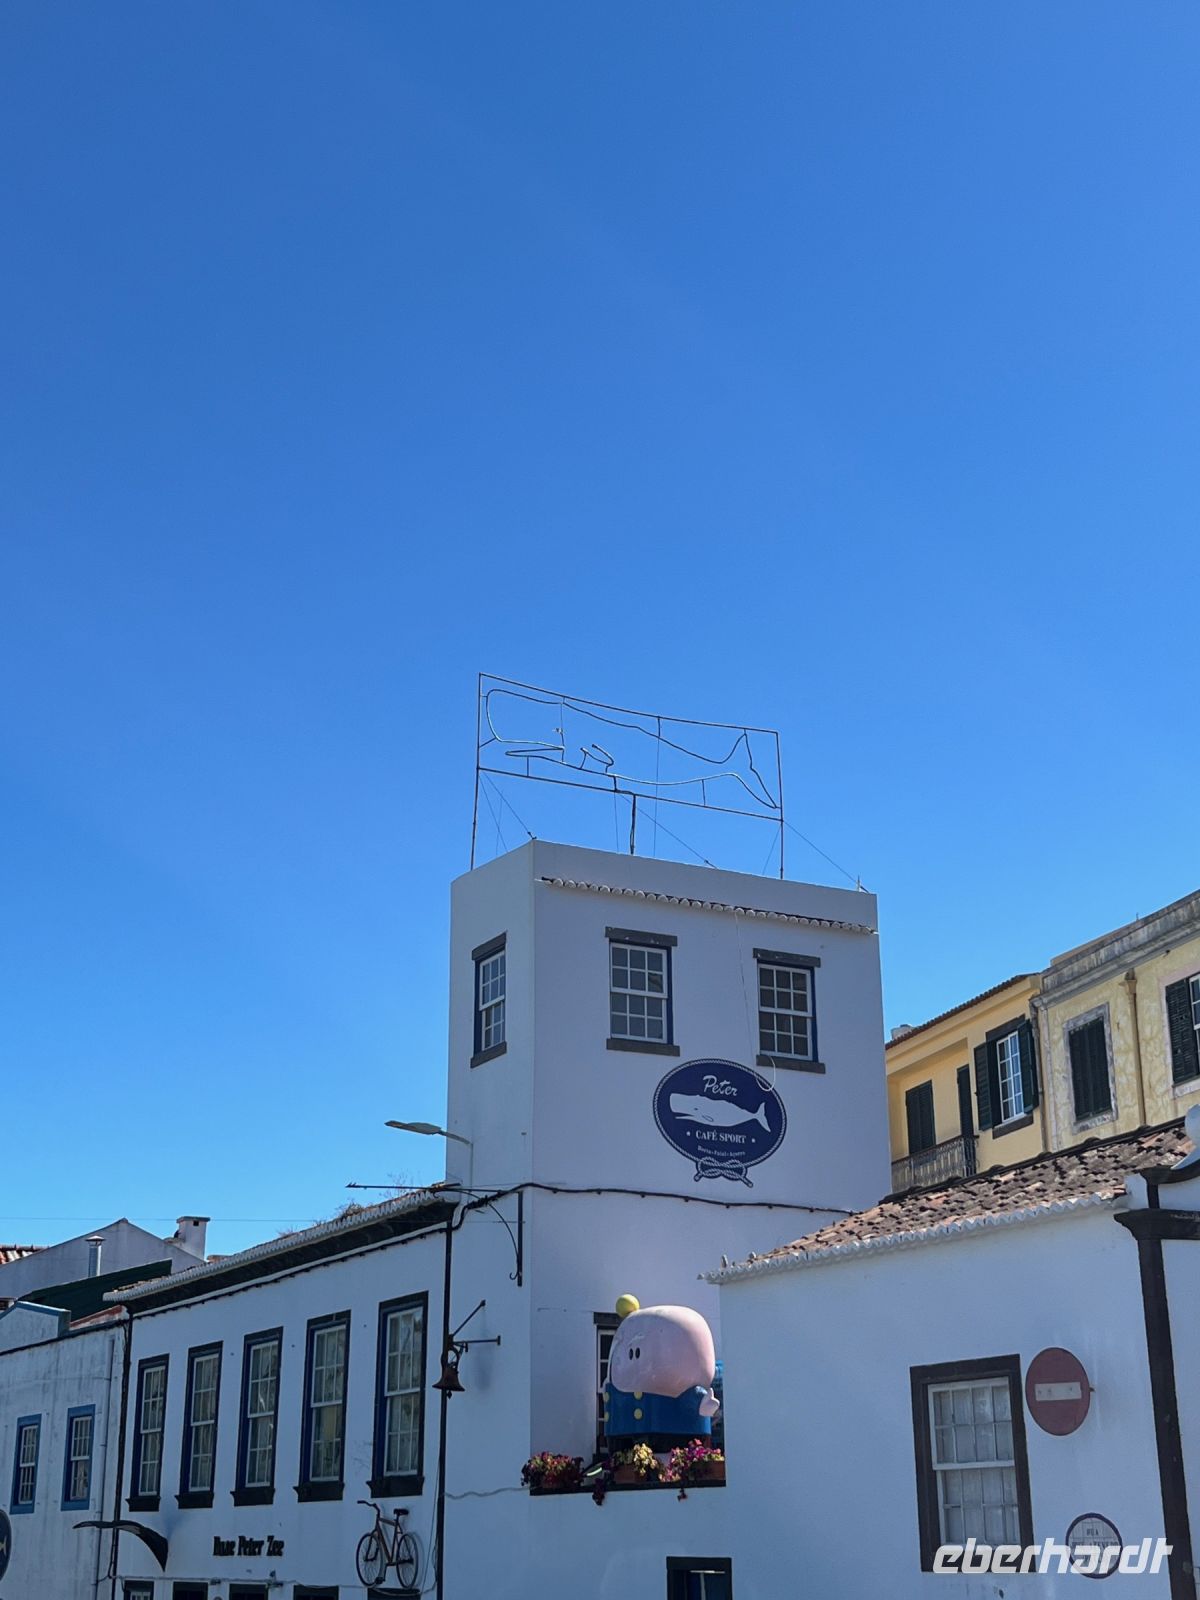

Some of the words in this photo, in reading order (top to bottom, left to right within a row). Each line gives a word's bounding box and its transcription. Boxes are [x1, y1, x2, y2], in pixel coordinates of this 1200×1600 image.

[702, 1075, 738, 1096] Peter
[695, 1129, 718, 1141] CAFÉ
[719, 1132, 746, 1144] SPORT
[237, 1535, 265, 1556] Peter
[266, 1535, 285, 1556] Zee
